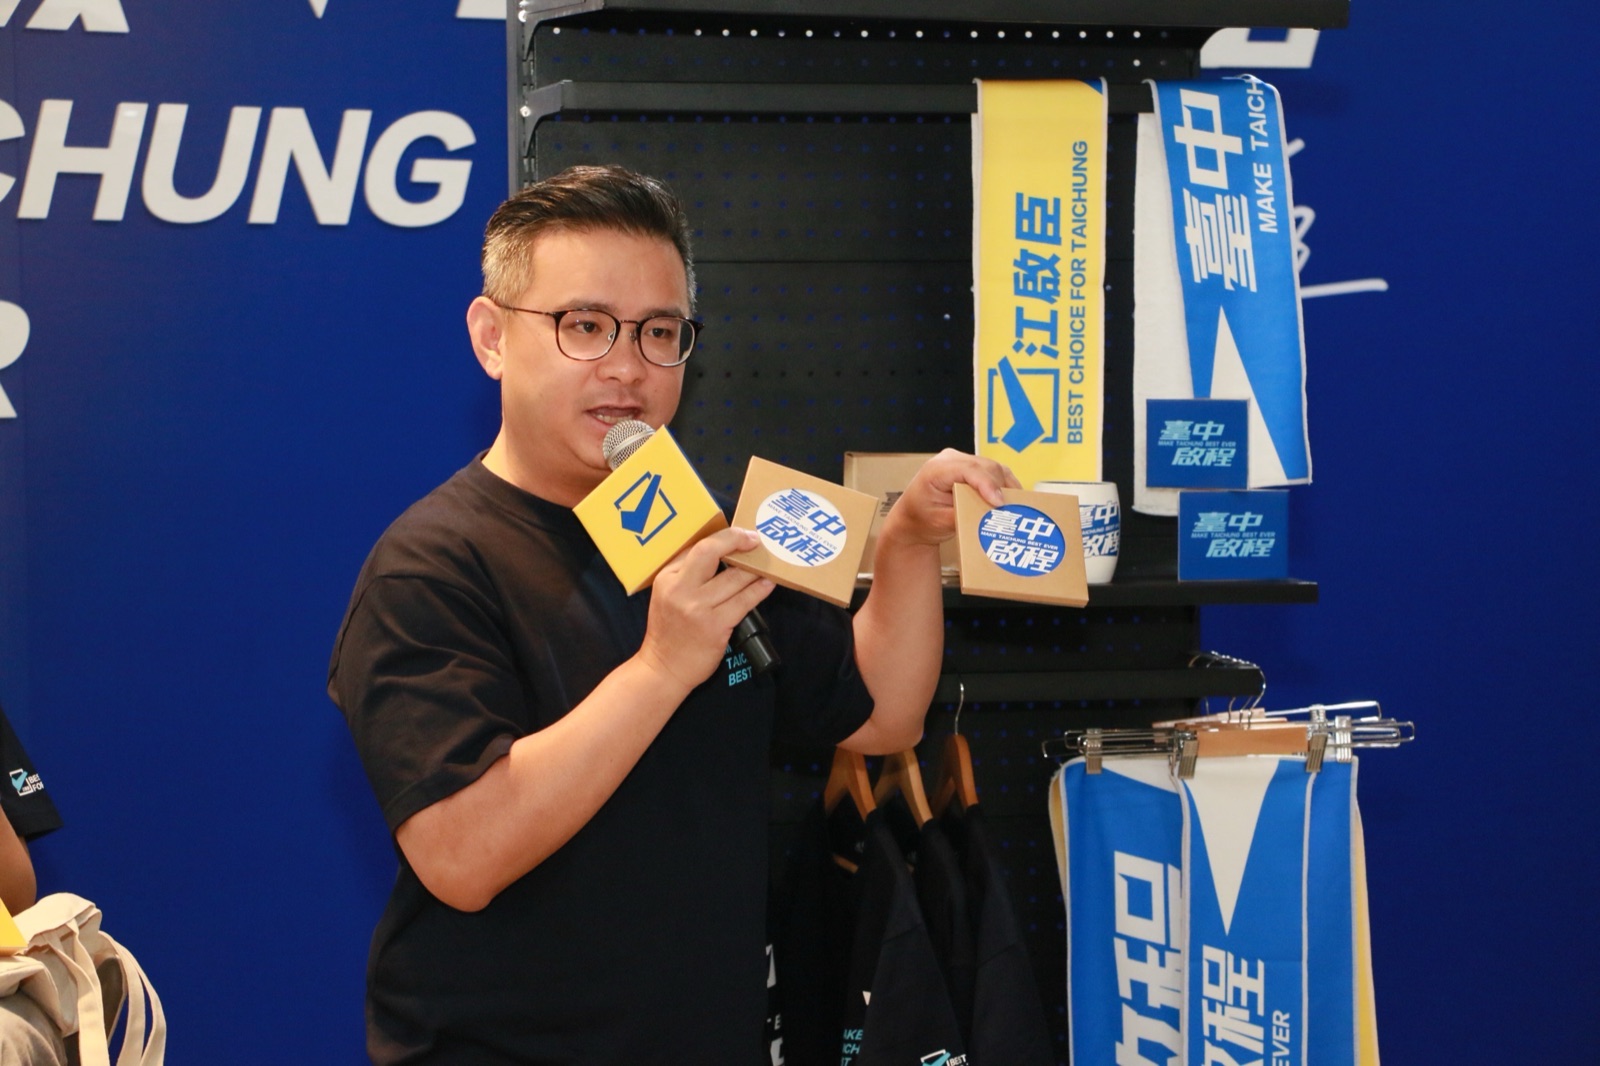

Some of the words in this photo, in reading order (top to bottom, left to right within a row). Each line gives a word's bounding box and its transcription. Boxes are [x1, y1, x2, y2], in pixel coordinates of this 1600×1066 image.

[0, 99, 477, 228] HUNG
[1071, 140, 1088, 252] TAICHUNG
[1173, 88, 1257, 293] 臺中
[1252, 162, 1278, 233] MAKE
[1012, 191, 1062, 360] 江啟臣
[1070, 258, 1087, 300] FOR
[1068, 305, 1086, 384] CHOICE
[1067, 389, 1084, 444] BEST
[1159, 420, 1225, 441] 臺中
[767, 503, 782, 514] MAKE
[783, 513, 809, 532] TAICHUNG
[808, 530, 823, 541] BEST
[823, 539, 837, 551] EVER
[771, 488, 846, 536] 臺中
[981, 509, 1056, 541] 臺中
[1192, 512, 1263, 532] 臺中
[998, 534, 1026, 544] TAICHUNG
[1043, 543, 1058, 551] EVER
[728, 666, 752, 686] BEST
